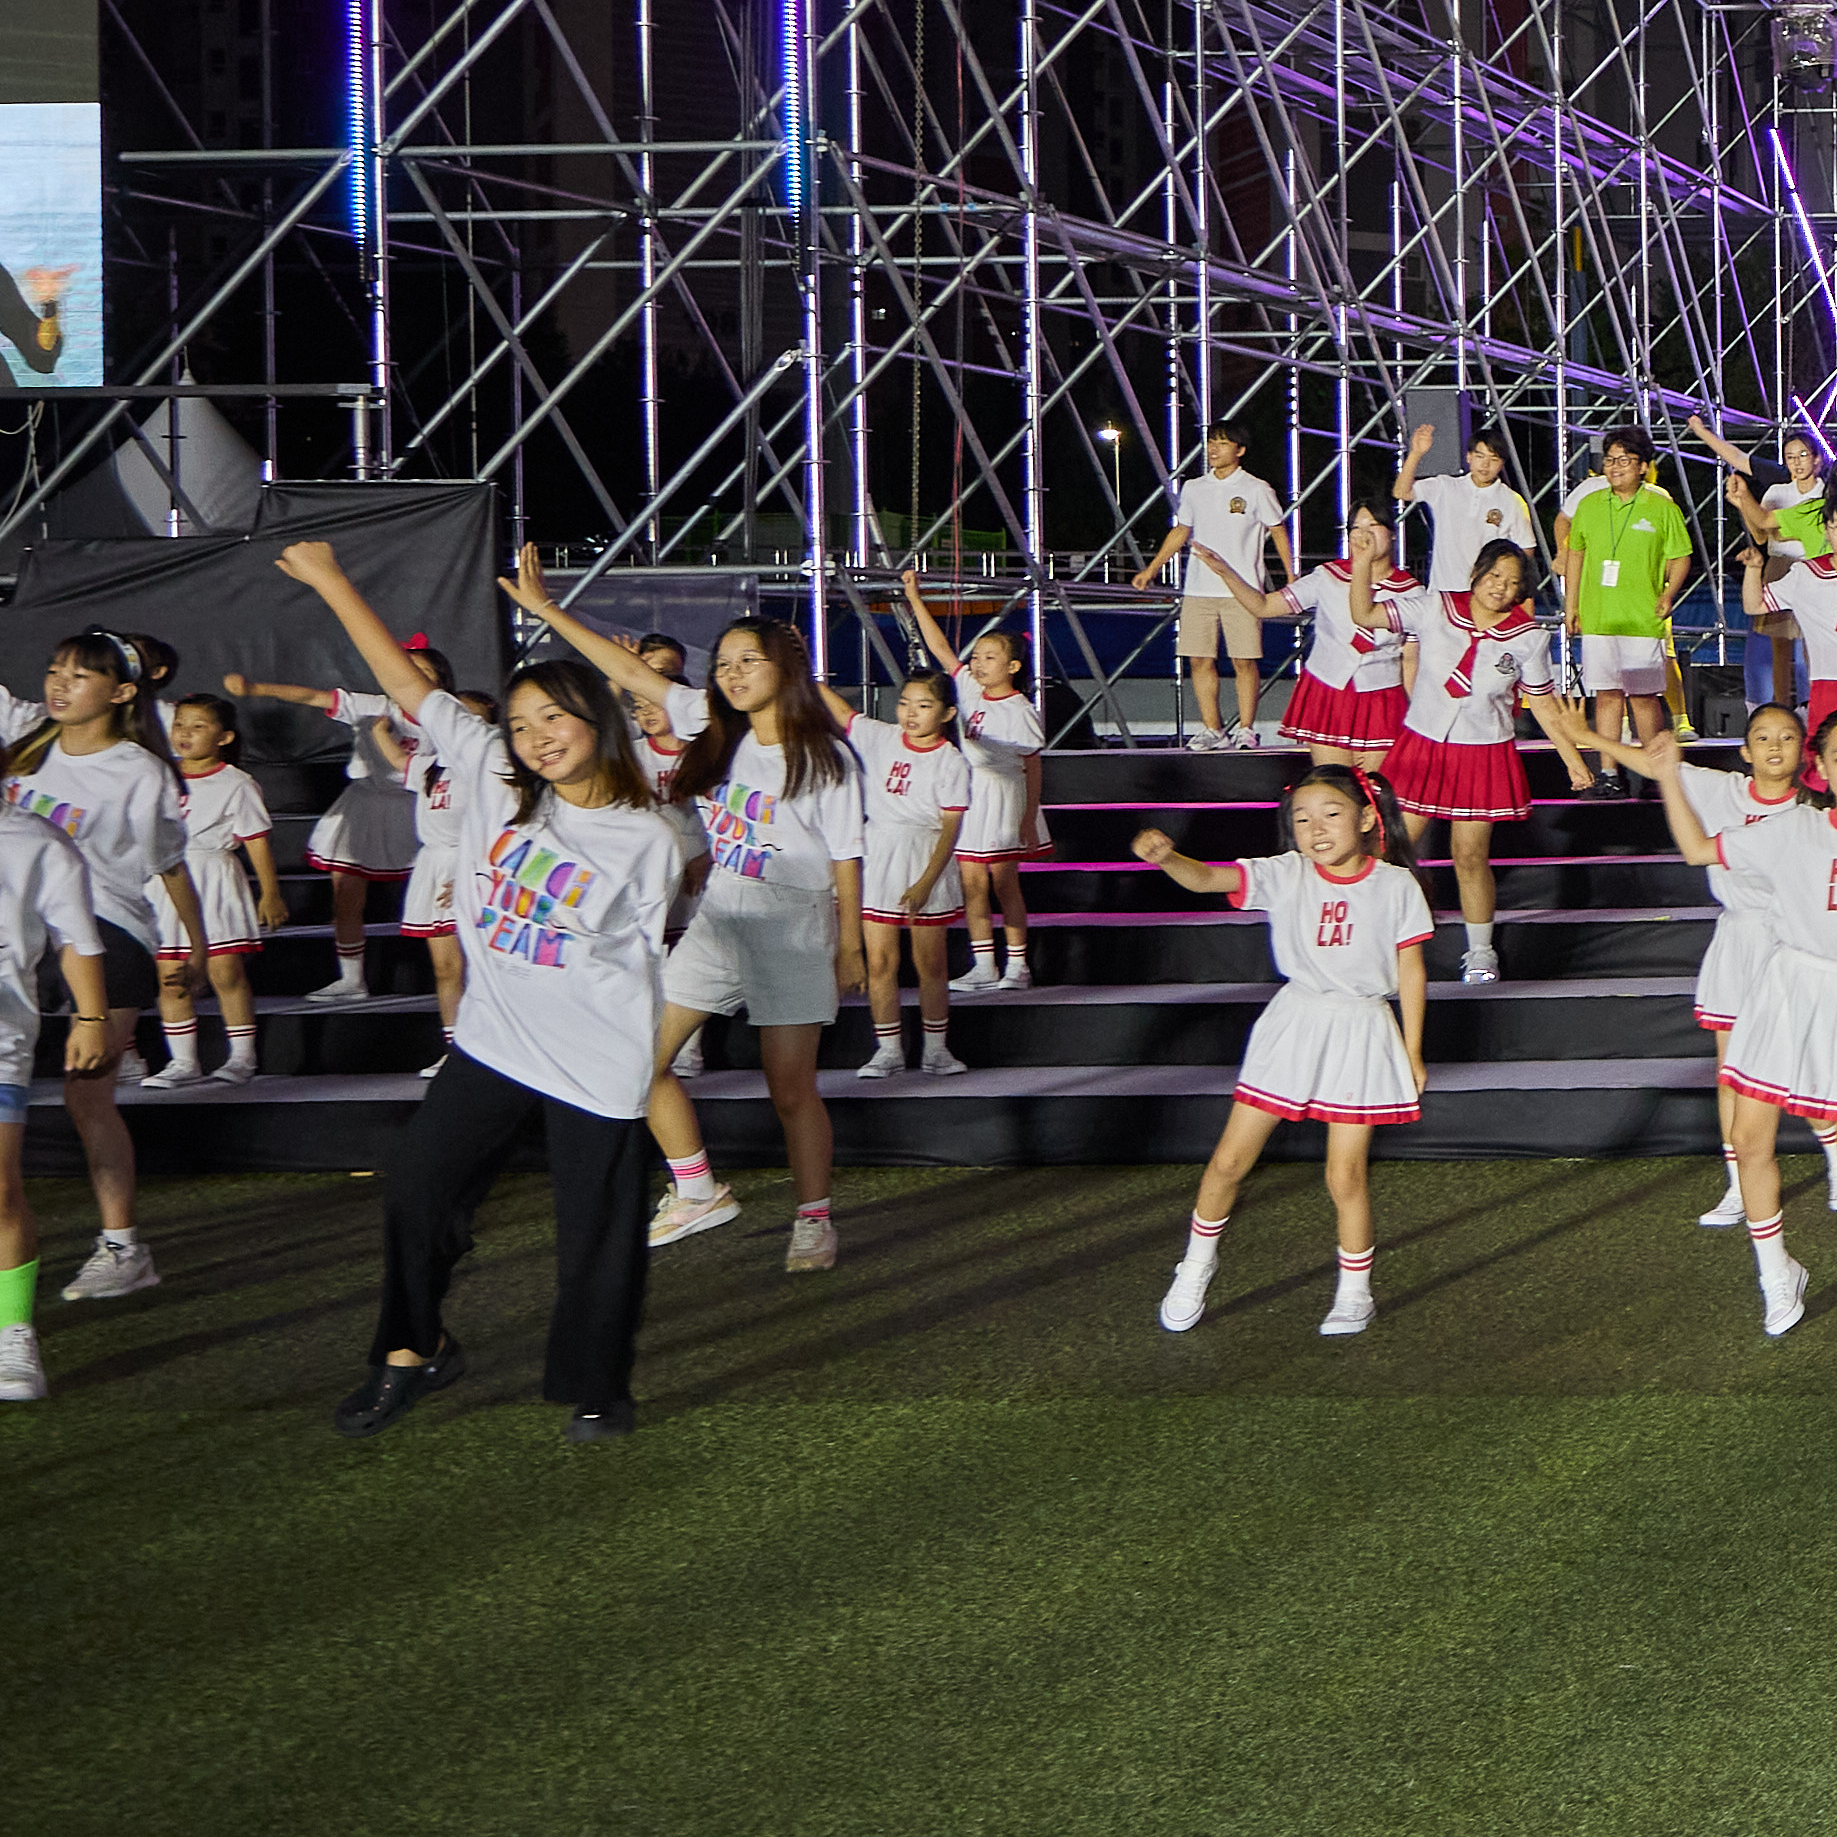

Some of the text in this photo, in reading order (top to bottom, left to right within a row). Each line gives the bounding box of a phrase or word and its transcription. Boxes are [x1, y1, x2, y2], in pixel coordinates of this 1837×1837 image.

[889, 761, 911, 778] HO
[885, 777, 911, 796] LA!
[704, 780, 776, 825] ATCH
[488, 829, 598, 909] CATCH
[1320, 900, 1349, 923] HO
[1316, 924, 1354, 946] LA!
